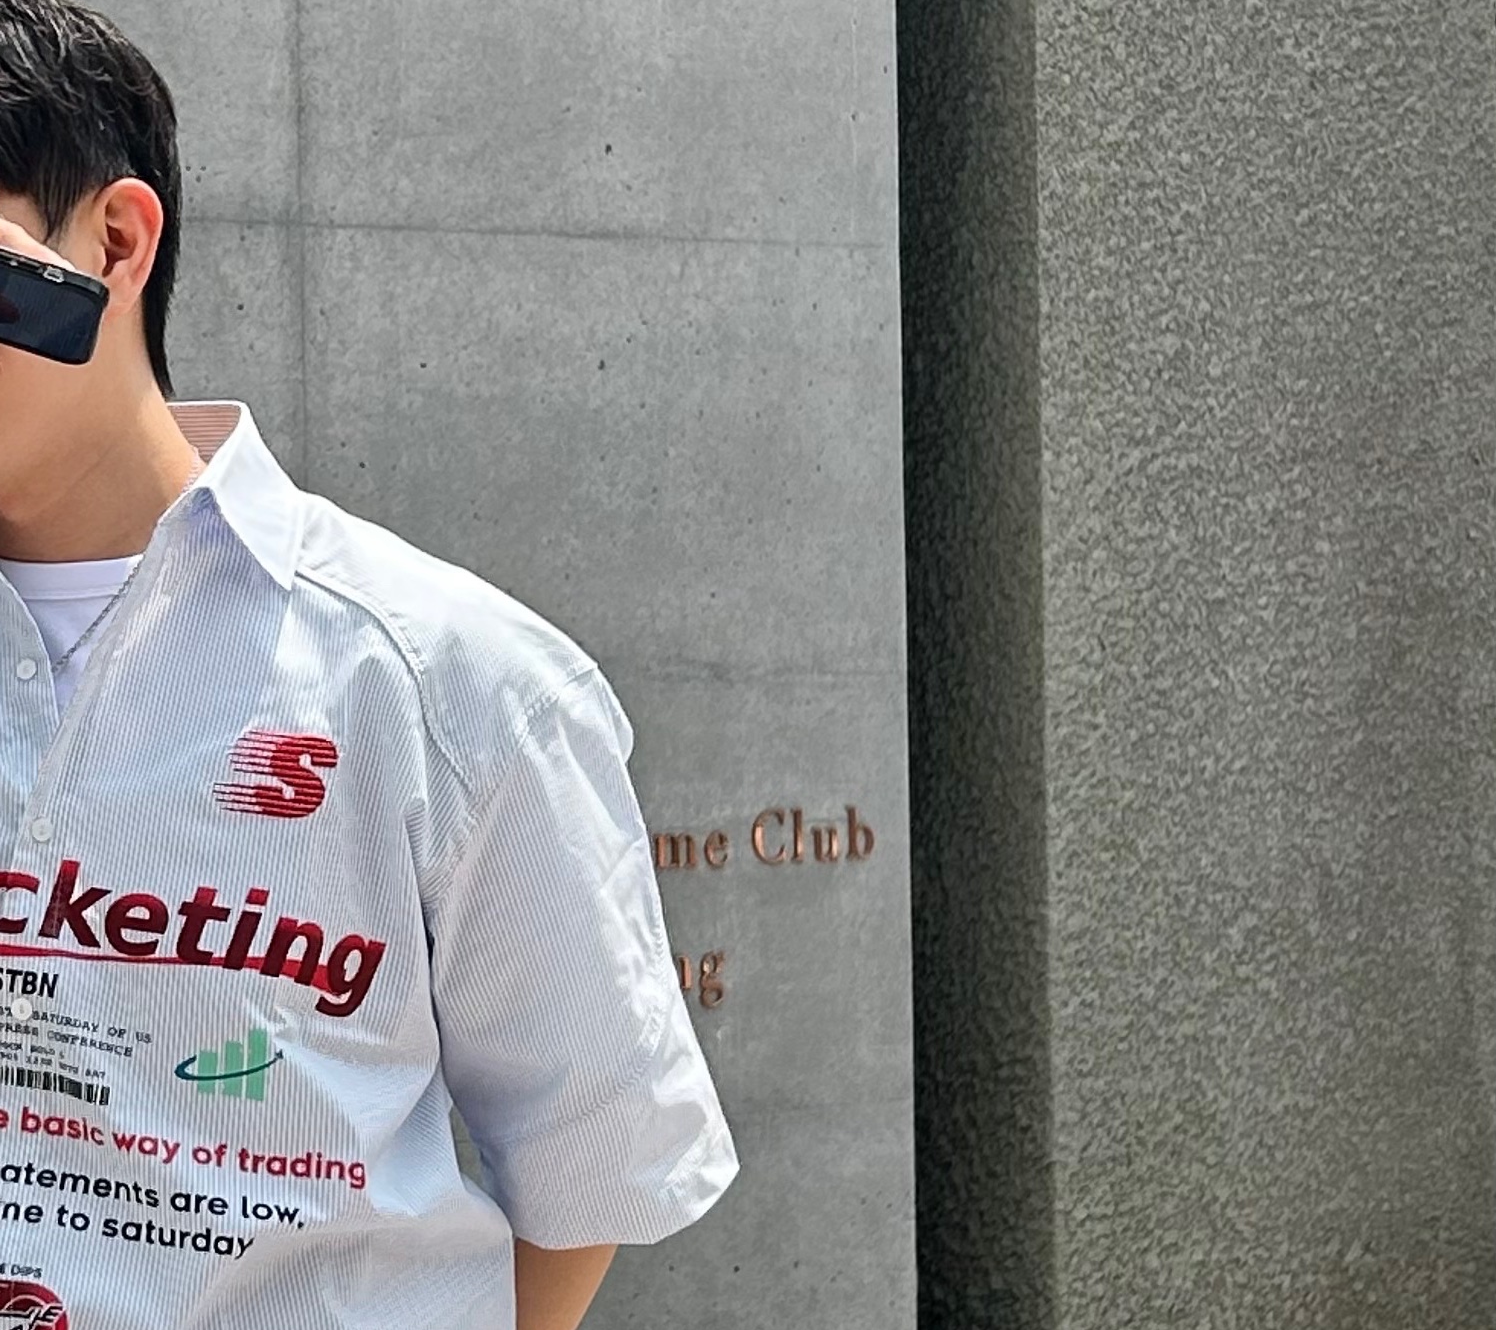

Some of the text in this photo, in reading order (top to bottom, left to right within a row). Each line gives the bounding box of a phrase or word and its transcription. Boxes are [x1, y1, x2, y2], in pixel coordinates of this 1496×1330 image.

[752, 805, 875, 865] Club
[47, 1029, 134, 1057] CONFERENCE
[21, 1106, 104, 1145] basic
[112, 1130, 180, 1164] way
[192, 1144, 227, 1167] of
[238, 1147, 365, 1189] trading
[57, 1204, 90, 1231] to
[102, 1219, 254, 1259] saturday
[170, 1191, 228, 1215] are
[242, 1196, 304, 1229] low,
